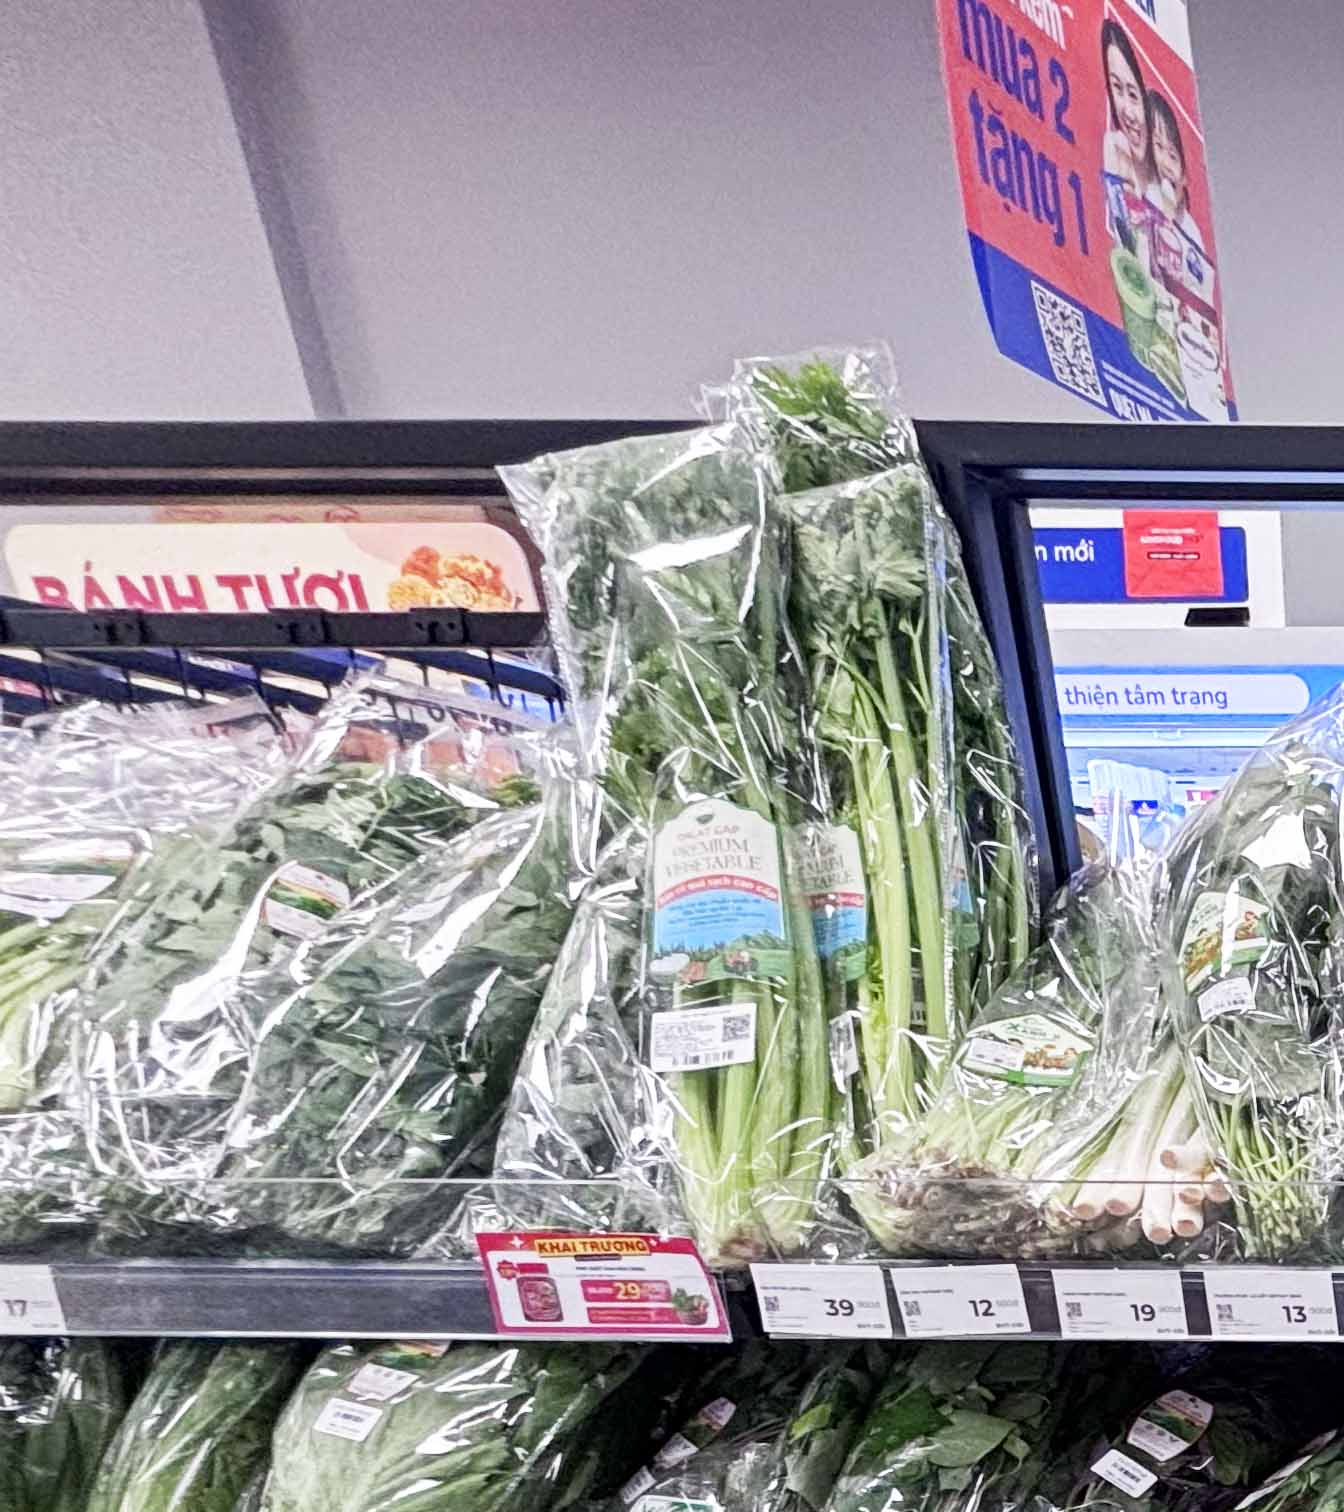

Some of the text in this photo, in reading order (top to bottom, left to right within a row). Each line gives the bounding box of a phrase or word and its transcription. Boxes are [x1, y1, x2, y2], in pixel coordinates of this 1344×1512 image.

[1049, 57, 1075, 144] 2
[969, 89, 1089, 255] tặng 1
[1054, 539, 1095, 562] mới
[1124, 683, 1166, 706] tâm
[823, 1299, 855, 1317] 39
[968, 1299, 996, 1317] 12
[1130, 1303, 1156, 1322] 19
[1281, 1305, 1307, 1323] 13
